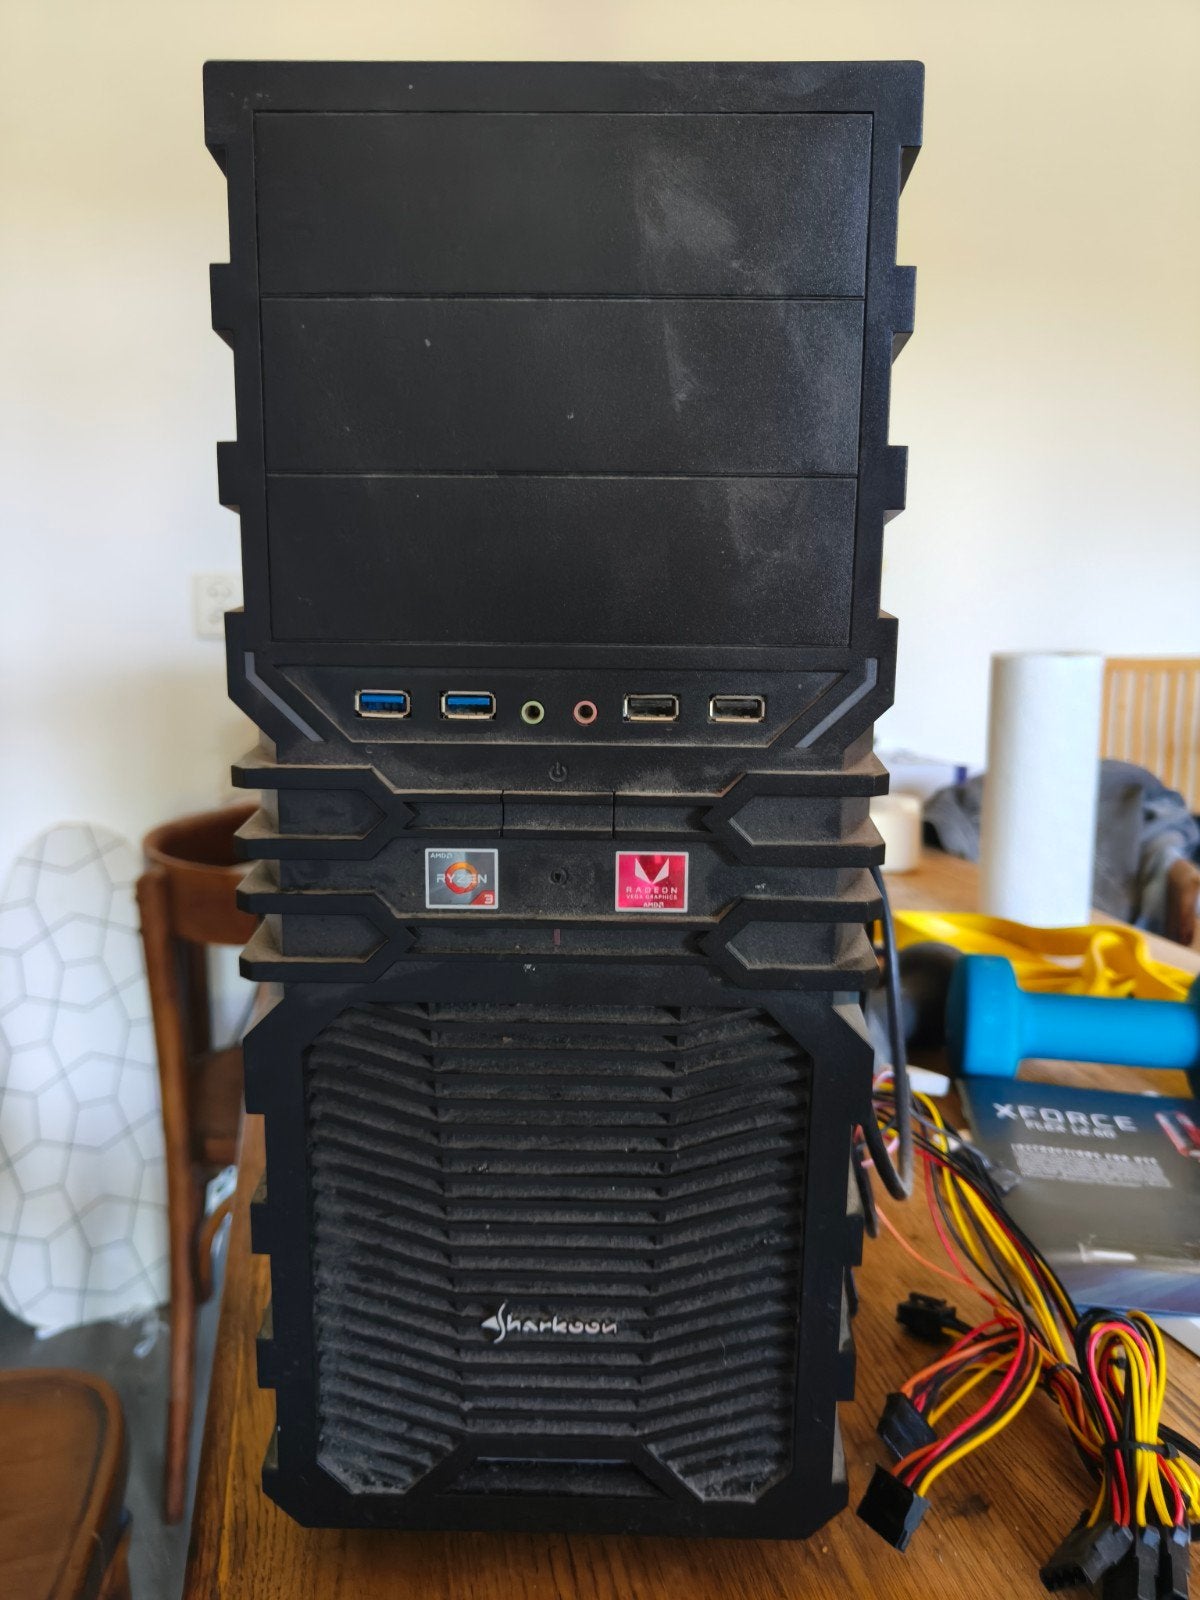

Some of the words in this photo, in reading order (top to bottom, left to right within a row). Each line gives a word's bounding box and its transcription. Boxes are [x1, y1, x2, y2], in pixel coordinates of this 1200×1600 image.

[436, 874, 487, 883] RYZEN
[484, 894, 493, 904] 3
[993, 1103, 1138, 1132] XFORCE
[481, 1299, 617, 1344] Sharkoon
